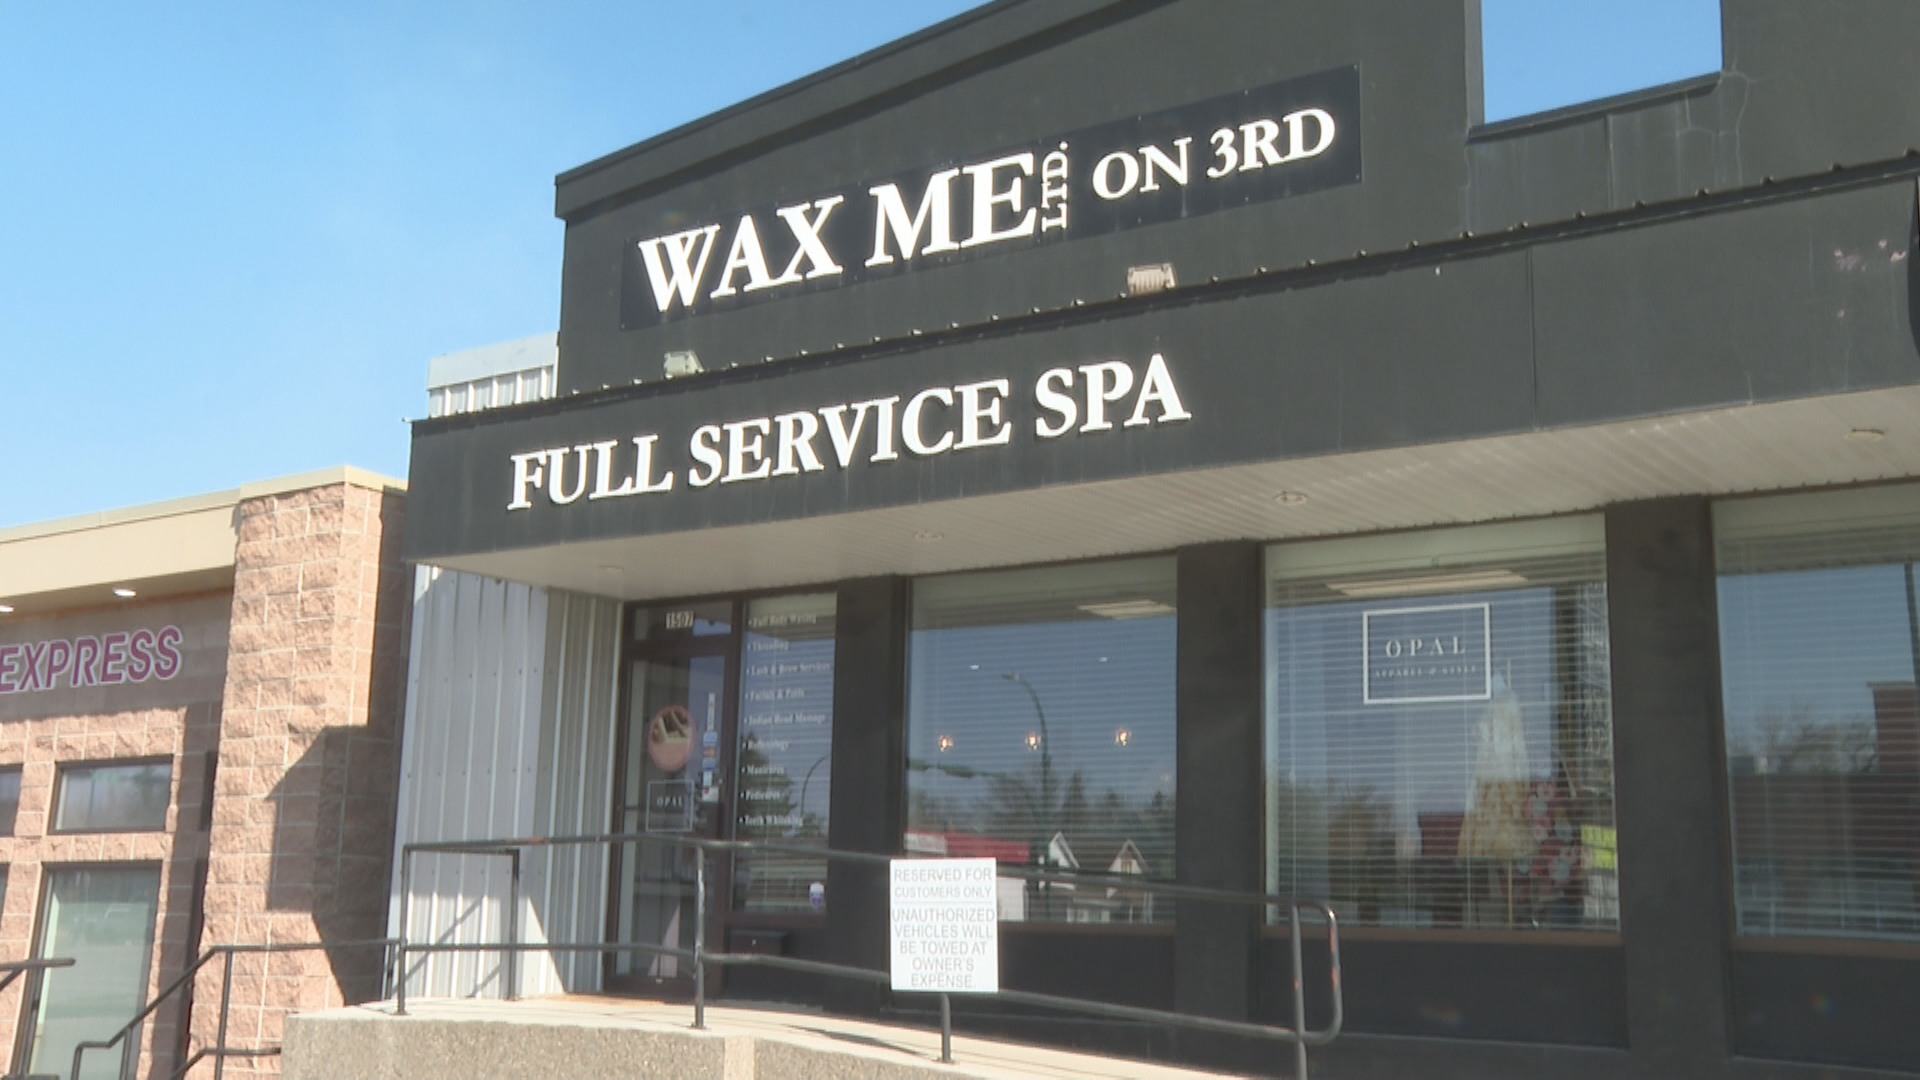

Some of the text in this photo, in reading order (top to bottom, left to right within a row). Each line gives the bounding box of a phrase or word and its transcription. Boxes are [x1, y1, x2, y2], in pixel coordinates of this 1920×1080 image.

[638, 109, 1336, 313] WAX ME LTD. ON 3RD
[507, 354, 1192, 510] FULL SERVICE SPA
[1385, 634, 1466, 658] OPAL
[0, 625, 182, 693] EXPRESS
[748, 712, 827, 726] Indian Head Massage
[747, 764, 785, 776] Manicures
[656, 795, 683, 807] OPAL
[746, 788, 781, 800] Pedicures
[745, 814, 765, 826] Teeth
[893, 867, 993, 882] RESERVED FOR
[894, 886, 993, 899] CUSTOMERS ONLY
[892, 907, 996, 922] UNAUTHORIZED
[894, 924, 994, 939] VEHICLES WILL
[899, 940, 988, 955] BE TOWED AT
[912, 956, 975, 972] OWNER'S
